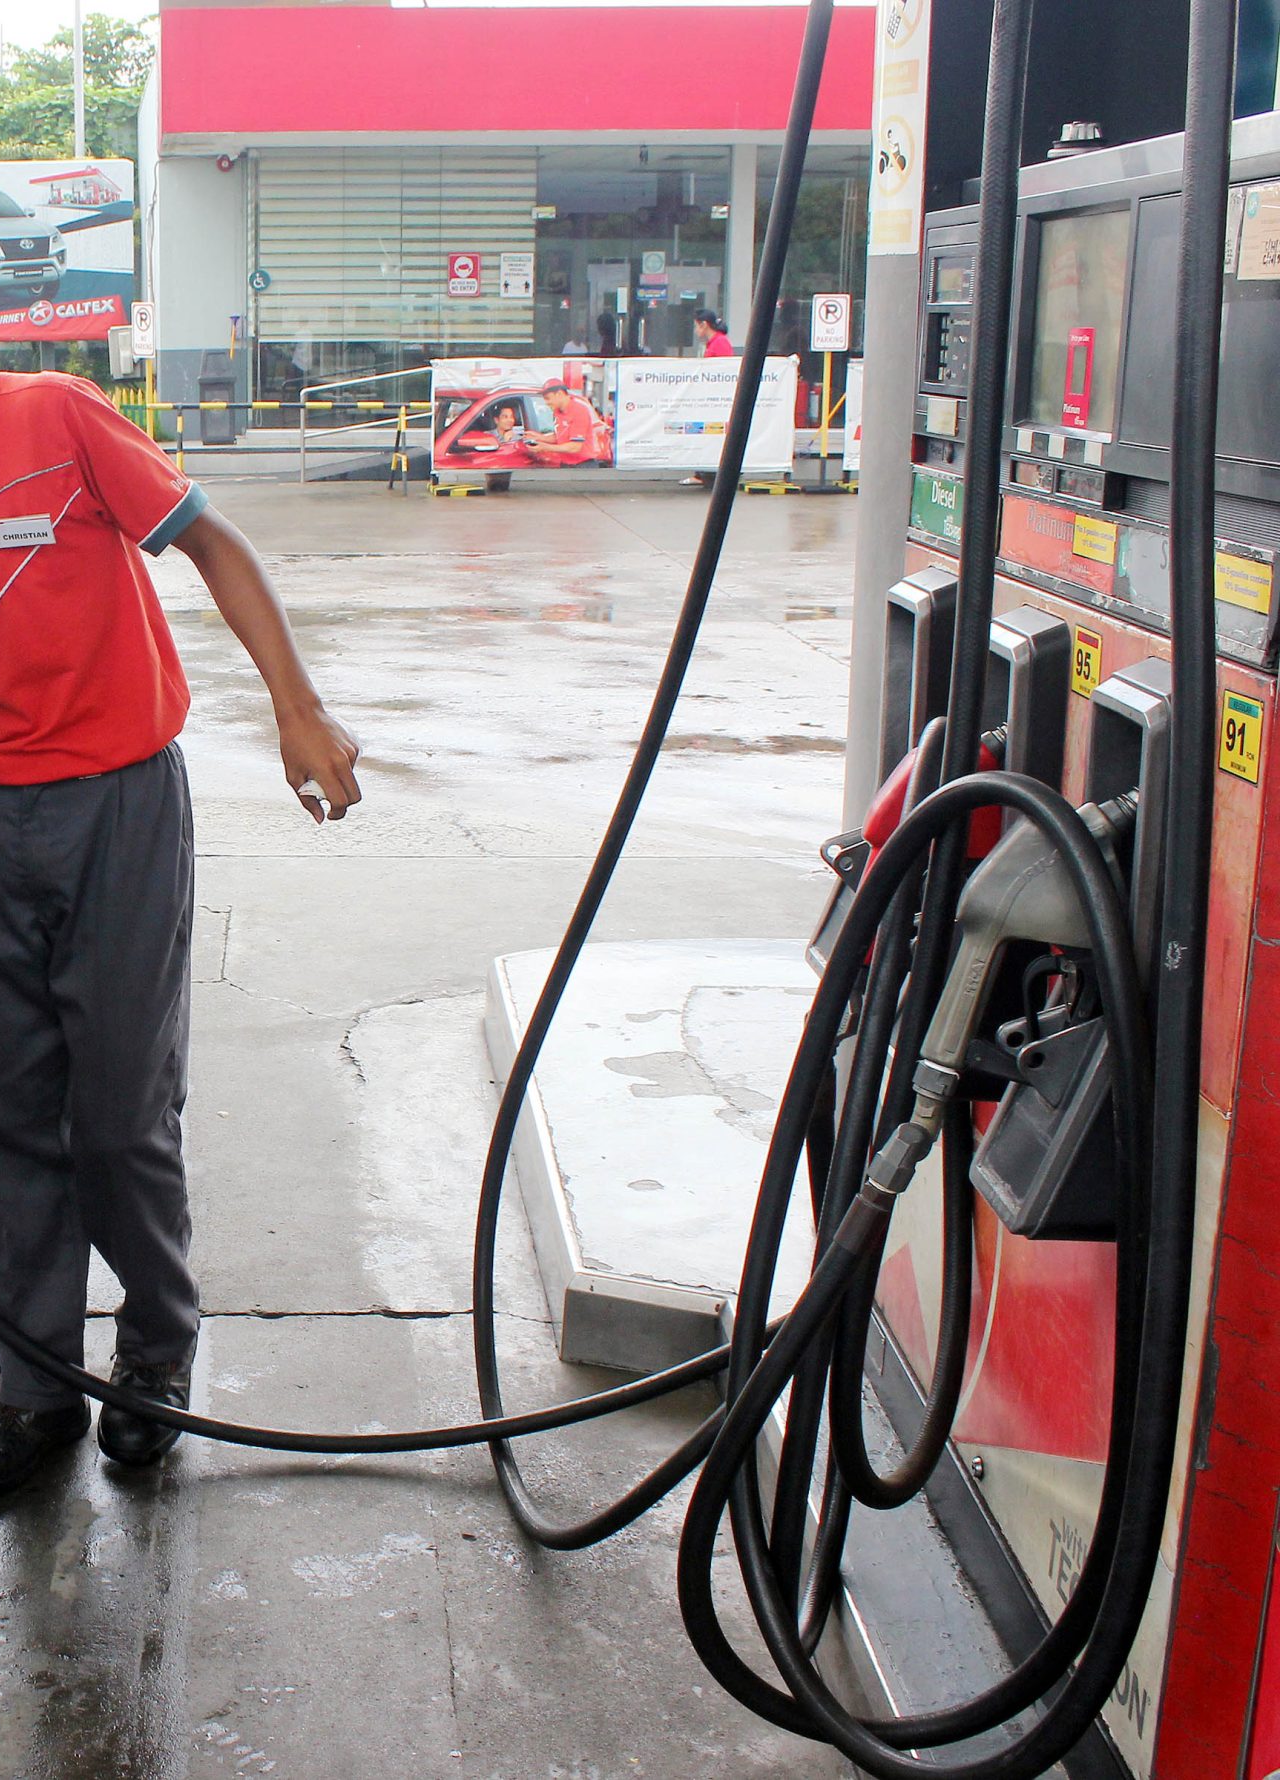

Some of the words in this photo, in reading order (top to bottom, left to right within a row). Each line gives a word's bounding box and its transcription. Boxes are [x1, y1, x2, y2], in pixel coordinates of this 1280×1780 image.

[55, 298, 116, 319] CALTEX
[816, 336, 845, 344] PARKING
[825, 327, 836, 336] NO
[644, 372, 700, 385] Philippine
[701, 372, 739, 384] Nation
[760, 373, 779, 383] ank
[931, 480, 957, 511] Diesel
[1027, 504, 1075, 542] Platinum
[3, 531, 49, 541] CHRISTIAN
[1076, 648, 1092, 681] 95
[1225, 717, 1246, 757] 91
